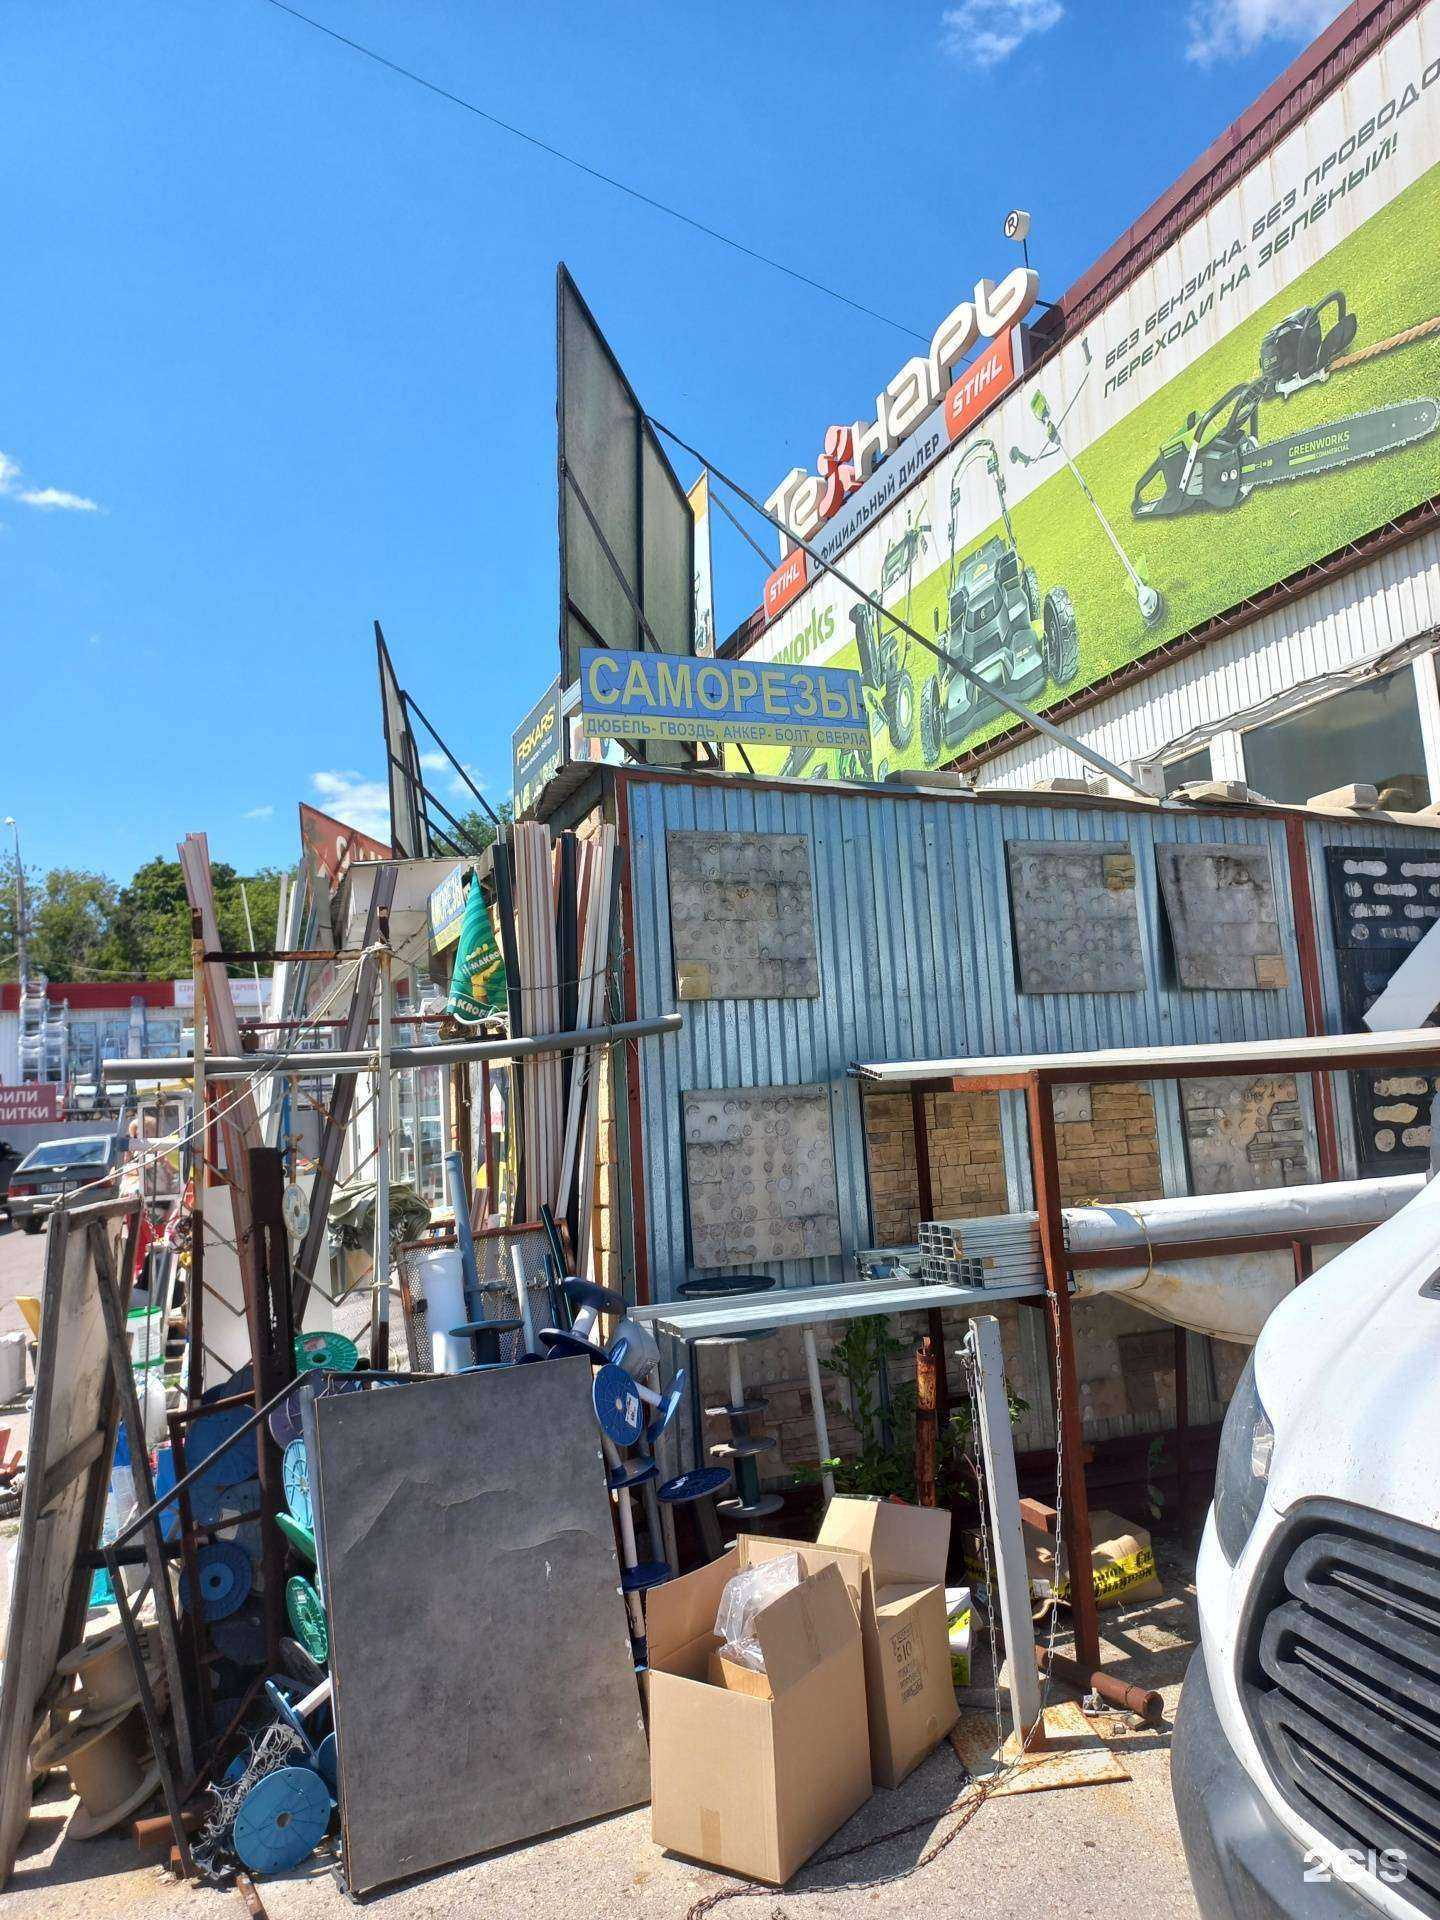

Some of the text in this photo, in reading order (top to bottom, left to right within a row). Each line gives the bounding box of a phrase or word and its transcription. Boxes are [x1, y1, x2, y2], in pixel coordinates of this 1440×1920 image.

[1104, 132, 1398, 399] ПЕРЕХОДИ НА ЗЕЛЁНЫЙ!
[1105, 328, 1140, 370] БЕЗ
[1145, 239, 1247, 335] БЕНЗИНА.
[1252, 188, 1297, 242] БЕЗ
[952, 353, 1004, 419] STIHL
[1288, 430, 1350, 457] GREENWORKS
[813, 433, 940, 570] ОФИЦИАЛЬНЫЙ ДИЛЕР
[769, 564, 800, 603] STIHL
[589, 656, 861, 720] САМОРЕЗЫ
[816, 730, 868, 746] СВЕРЛА
